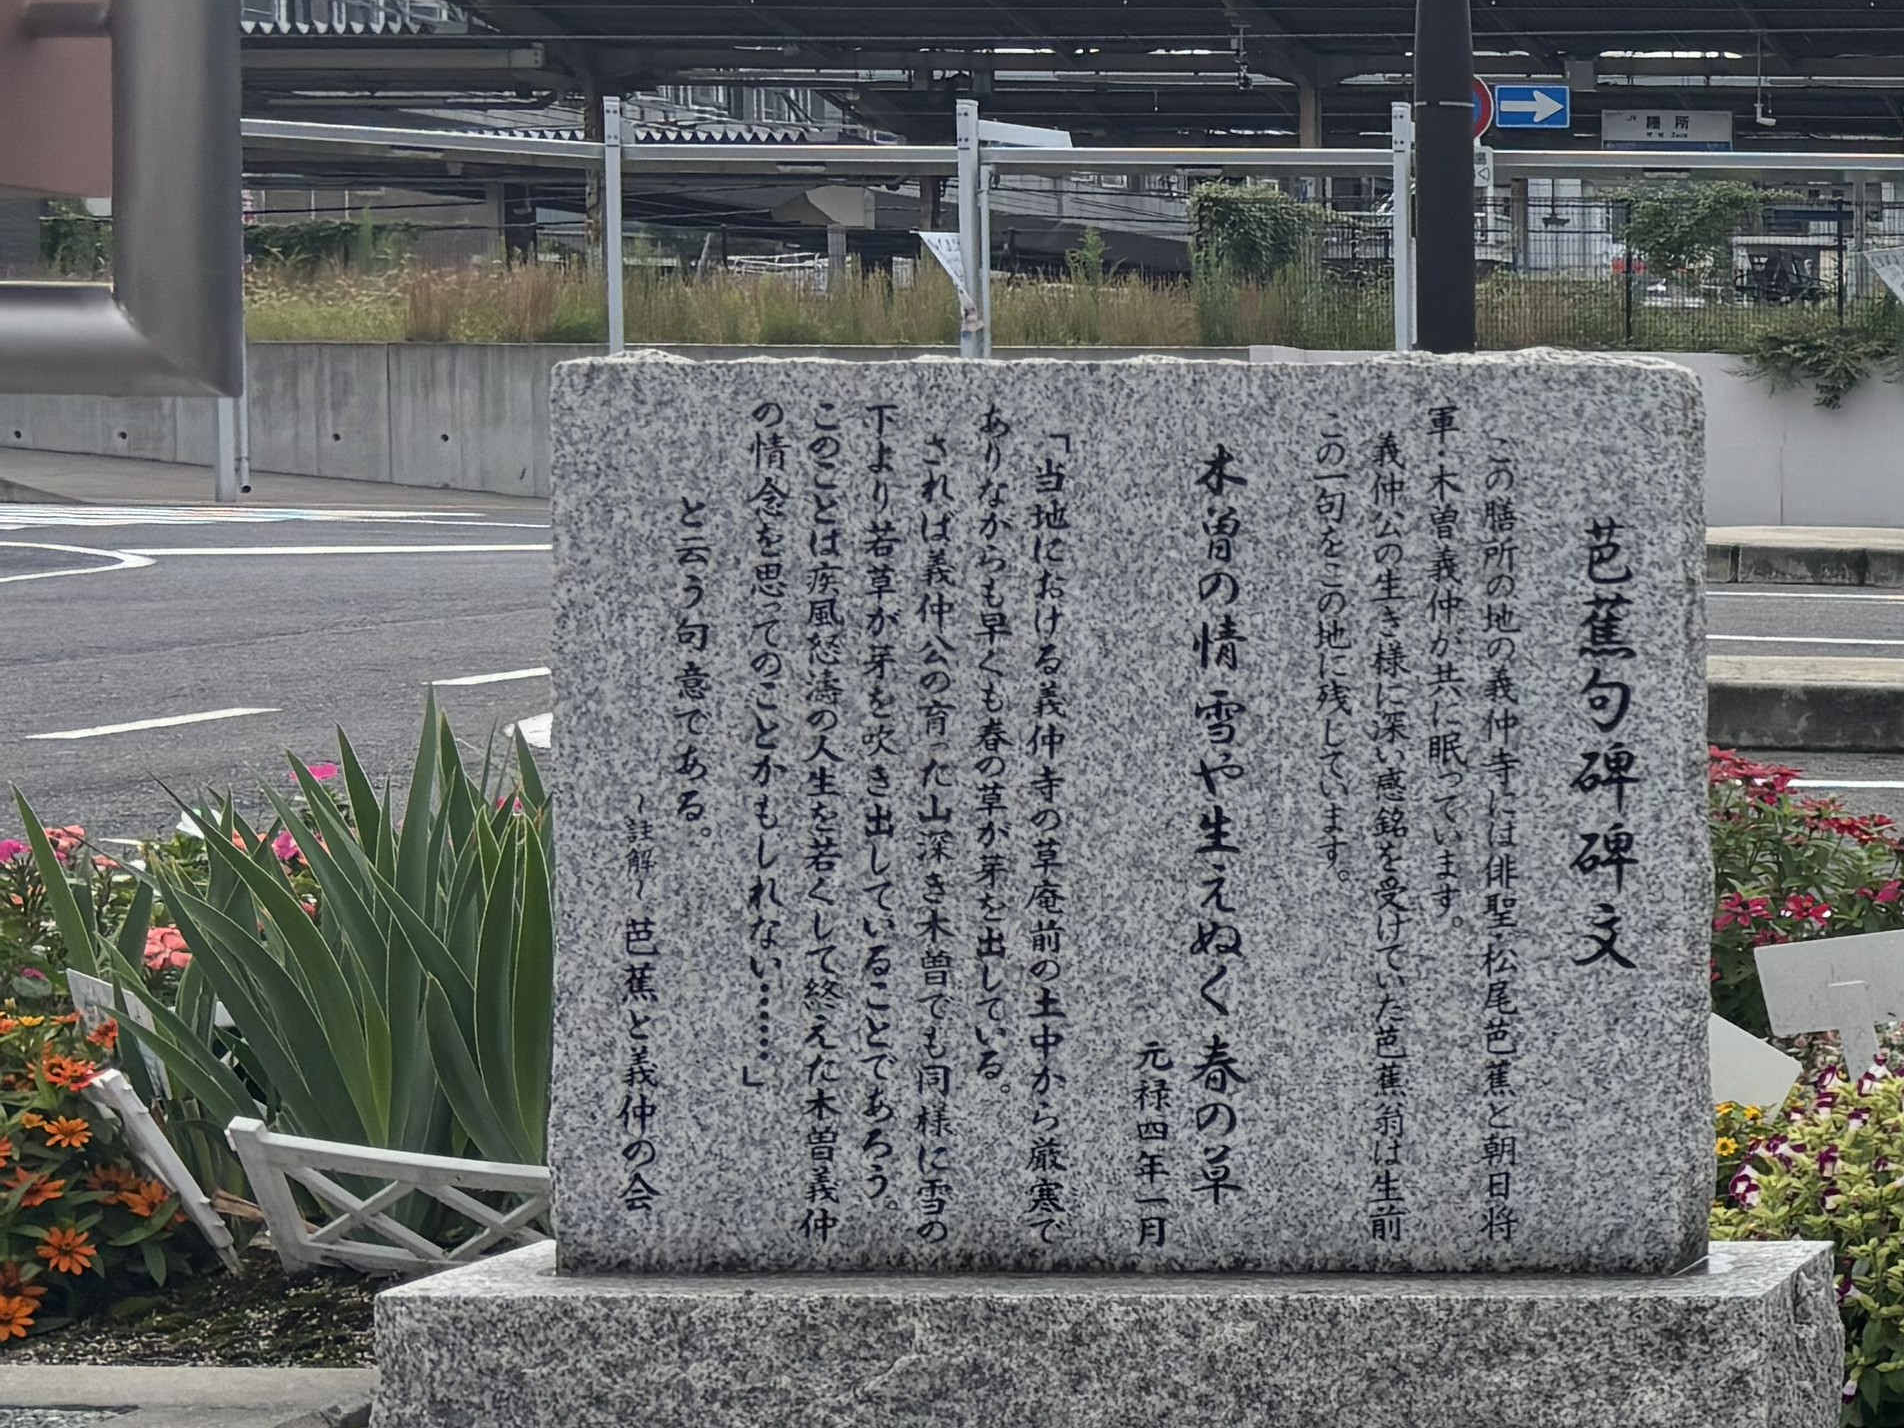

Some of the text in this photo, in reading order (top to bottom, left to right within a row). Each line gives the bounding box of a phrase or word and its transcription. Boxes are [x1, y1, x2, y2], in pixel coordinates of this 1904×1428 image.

[674, 495, 712, 838] と云う句意である。
[861, 403, 901, 1211] 下より若草が芽を吹き出していることであろう。
[974, 403, 1013, 1095] ありながらも早くも春の草が芽を出している。
[1313, 412, 1352, 883] この一句をこの地に残しています。
[1569, 515, 1641, 970] 芭蕉句碑碑文
[616, 916, 661, 1213] 芭蕉と義仲の会
[1133, 1040, 1174, 1249] 元禄四年一月
